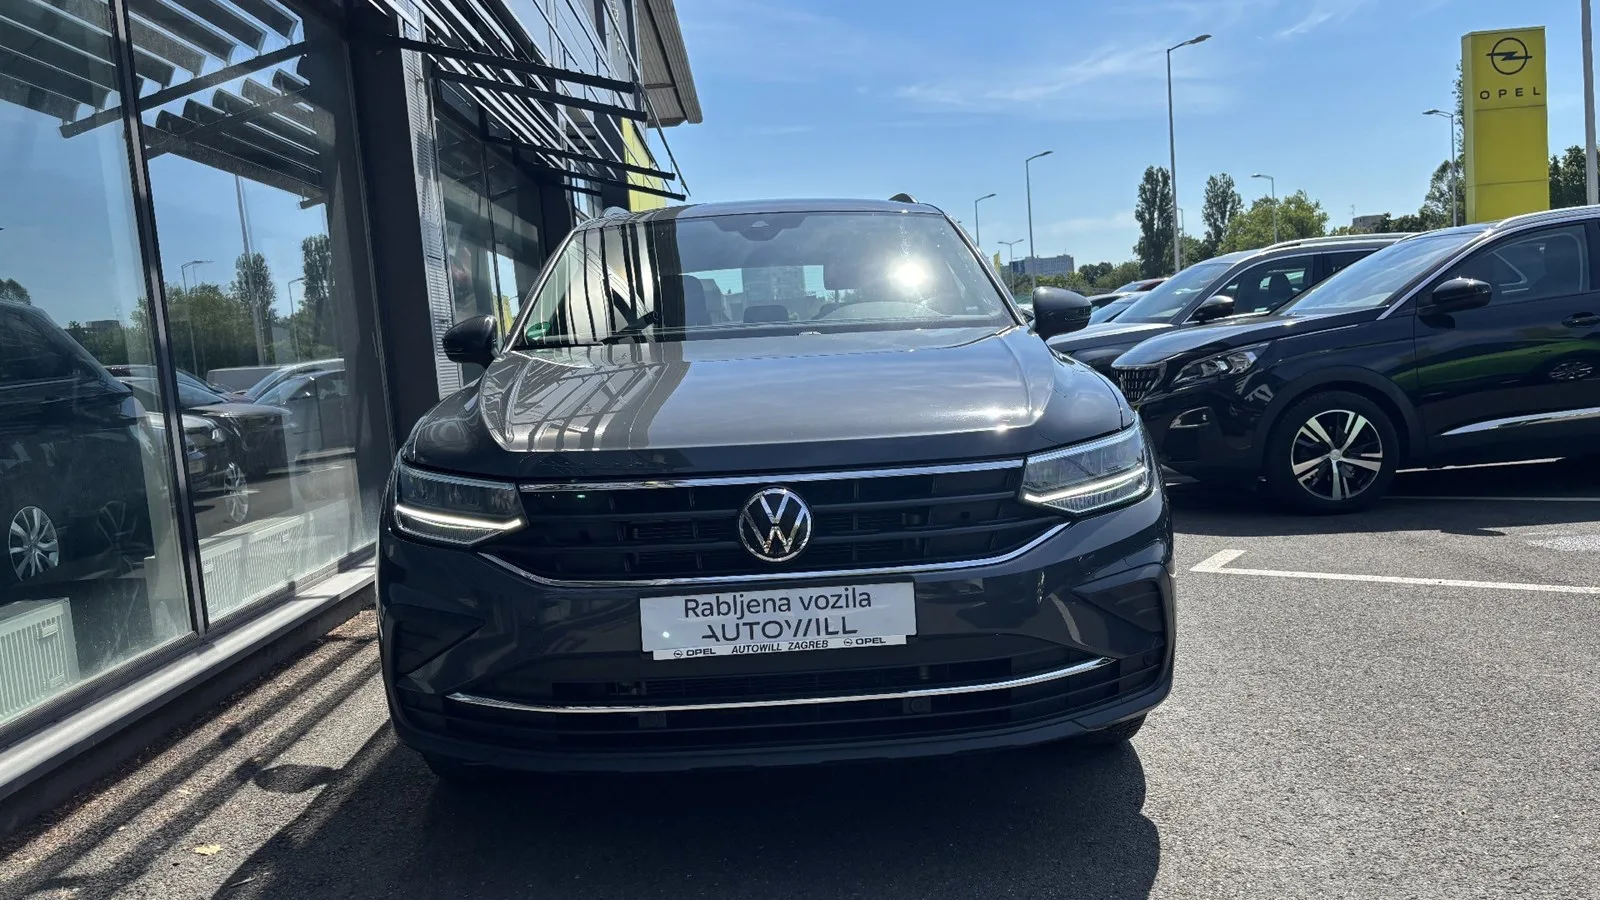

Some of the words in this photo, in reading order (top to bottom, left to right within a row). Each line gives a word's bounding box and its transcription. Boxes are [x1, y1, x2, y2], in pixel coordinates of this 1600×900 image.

[1479, 86, 1541, 100] OPEL
[684, 594, 792, 620] Rabljena
[798, 587, 872, 611] vozila
[701, 616, 858, 643] AUTOWILL
[686, 647, 717, 657] OPEL
[731, 642, 783, 655] AUTOWILL
[788, 639, 829, 651] ZAGREB
[855, 636, 887, 645] OPEL
